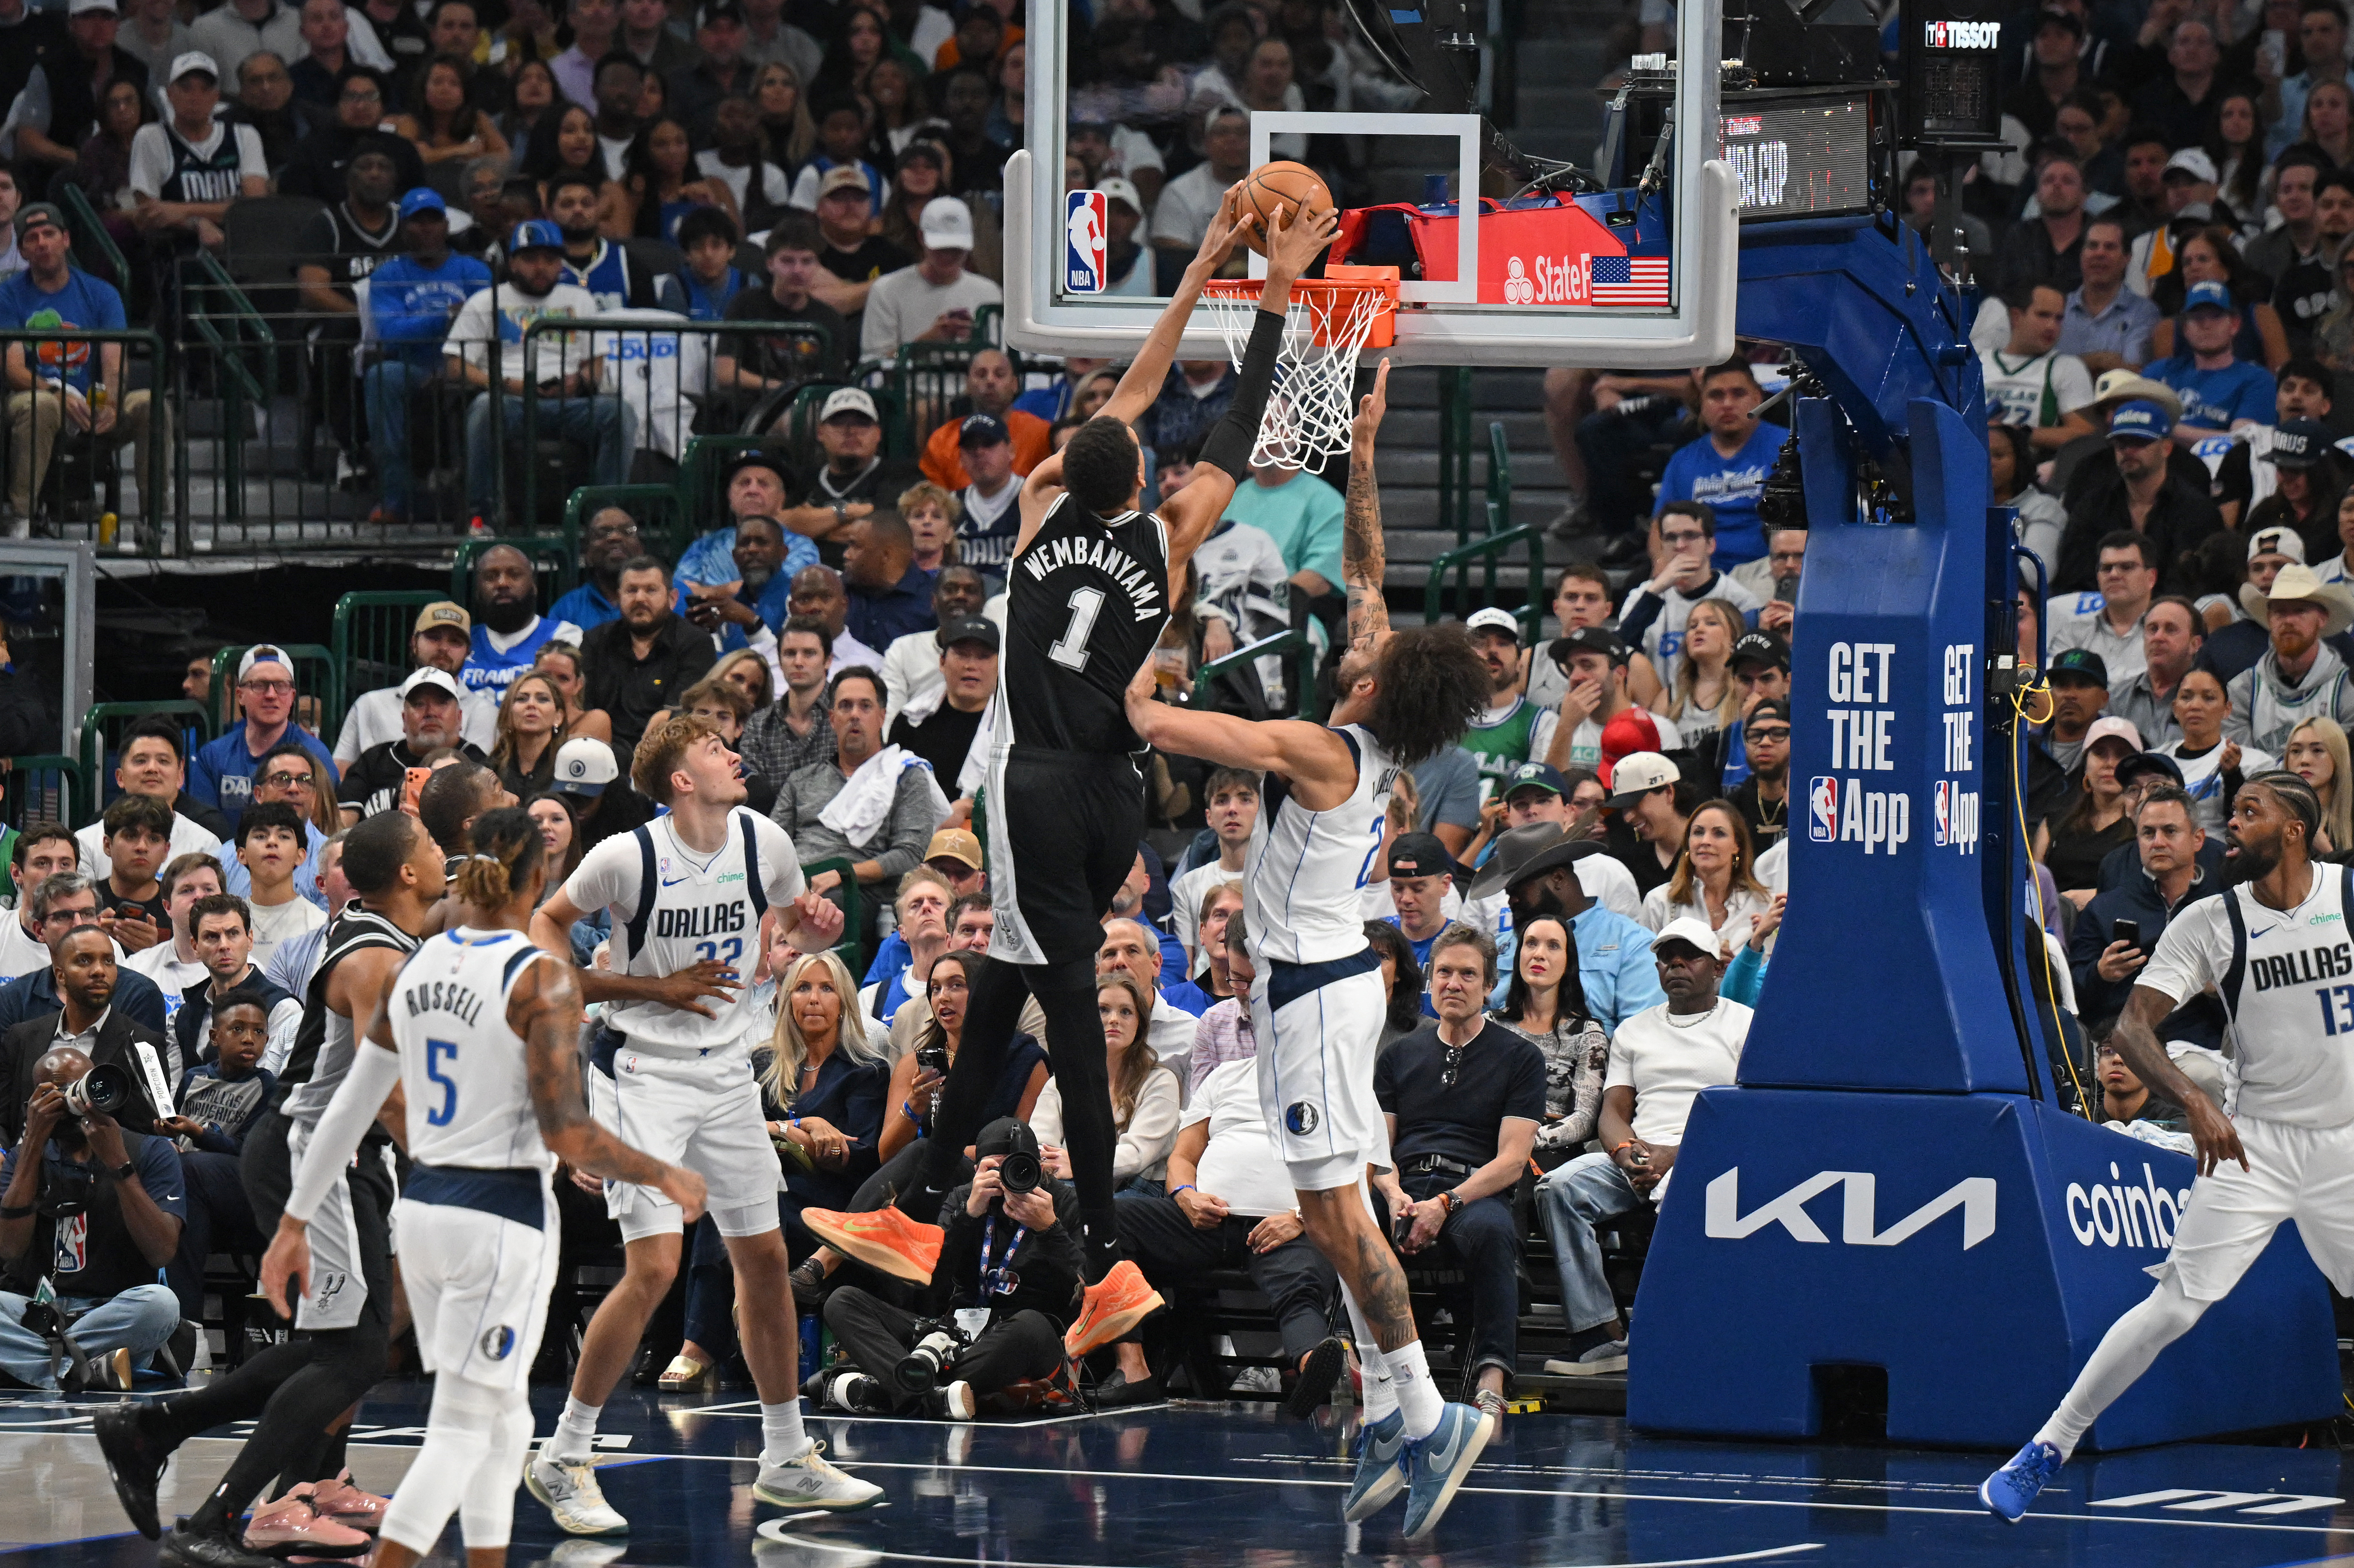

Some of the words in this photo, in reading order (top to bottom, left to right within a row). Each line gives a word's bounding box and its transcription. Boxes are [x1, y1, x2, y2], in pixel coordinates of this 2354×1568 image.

[1946, 21, 2001, 49] TISSOT
[1758, 141, 1788, 206] CUP
[1071, 270, 1091, 287] NBA
[1535, 253, 1592, 302] StateF
[1024, 536, 1161, 622] WEMBANYAMA
[1048, 586, 1106, 673] 1
[1828, 641, 1896, 703] GET
[1943, 644, 1974, 706] GET
[1827, 710, 1895, 771] THE
[1942, 711, 1973, 772] THE
[1813, 826, 1826, 837] NBA
[1840, 778, 1909, 855] App
[1949, 781, 1979, 855] App
[717, 872, 746, 885] chime
[657, 900, 746, 939] DALLAS
[2309, 912, 2343, 926] chime
[2250, 942, 2352, 992] DALLAS
[405, 981, 484, 1028] RUSSELL
[2315, 983, 2354, 1037] 13
[149, 1067, 166, 1099] POPCORN
[199, 1088, 243, 1109] DALLAS
[426, 1037, 458, 1127] 5
